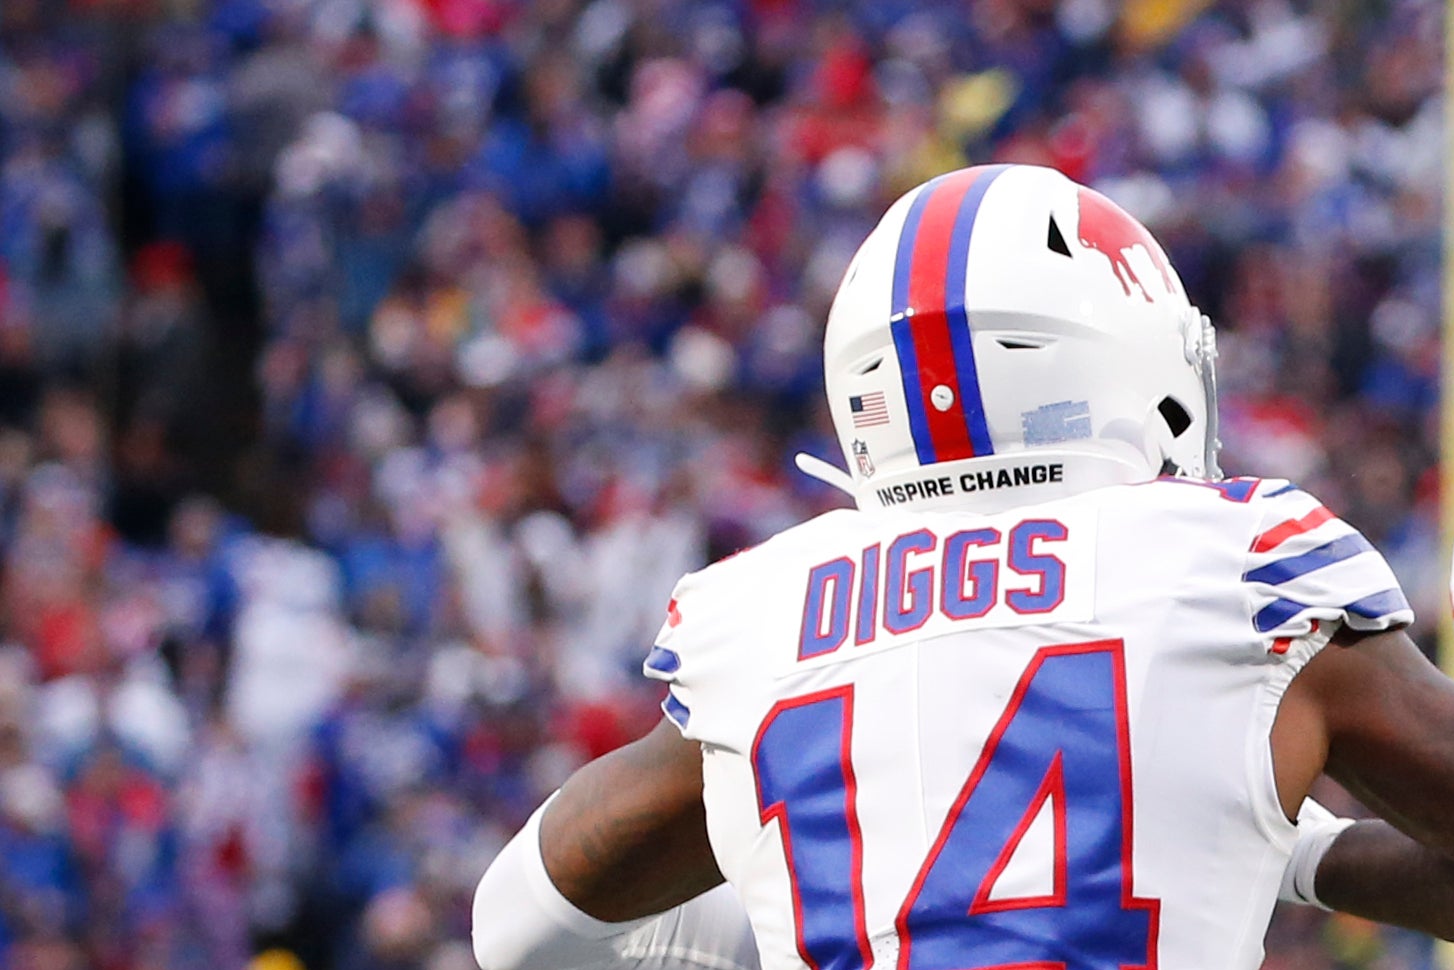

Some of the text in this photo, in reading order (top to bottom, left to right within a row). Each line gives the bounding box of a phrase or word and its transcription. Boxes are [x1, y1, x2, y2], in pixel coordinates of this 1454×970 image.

[877, 464, 1063, 507] INSPIRE CHANGE
[797, 518, 1069, 662] DIGGS
